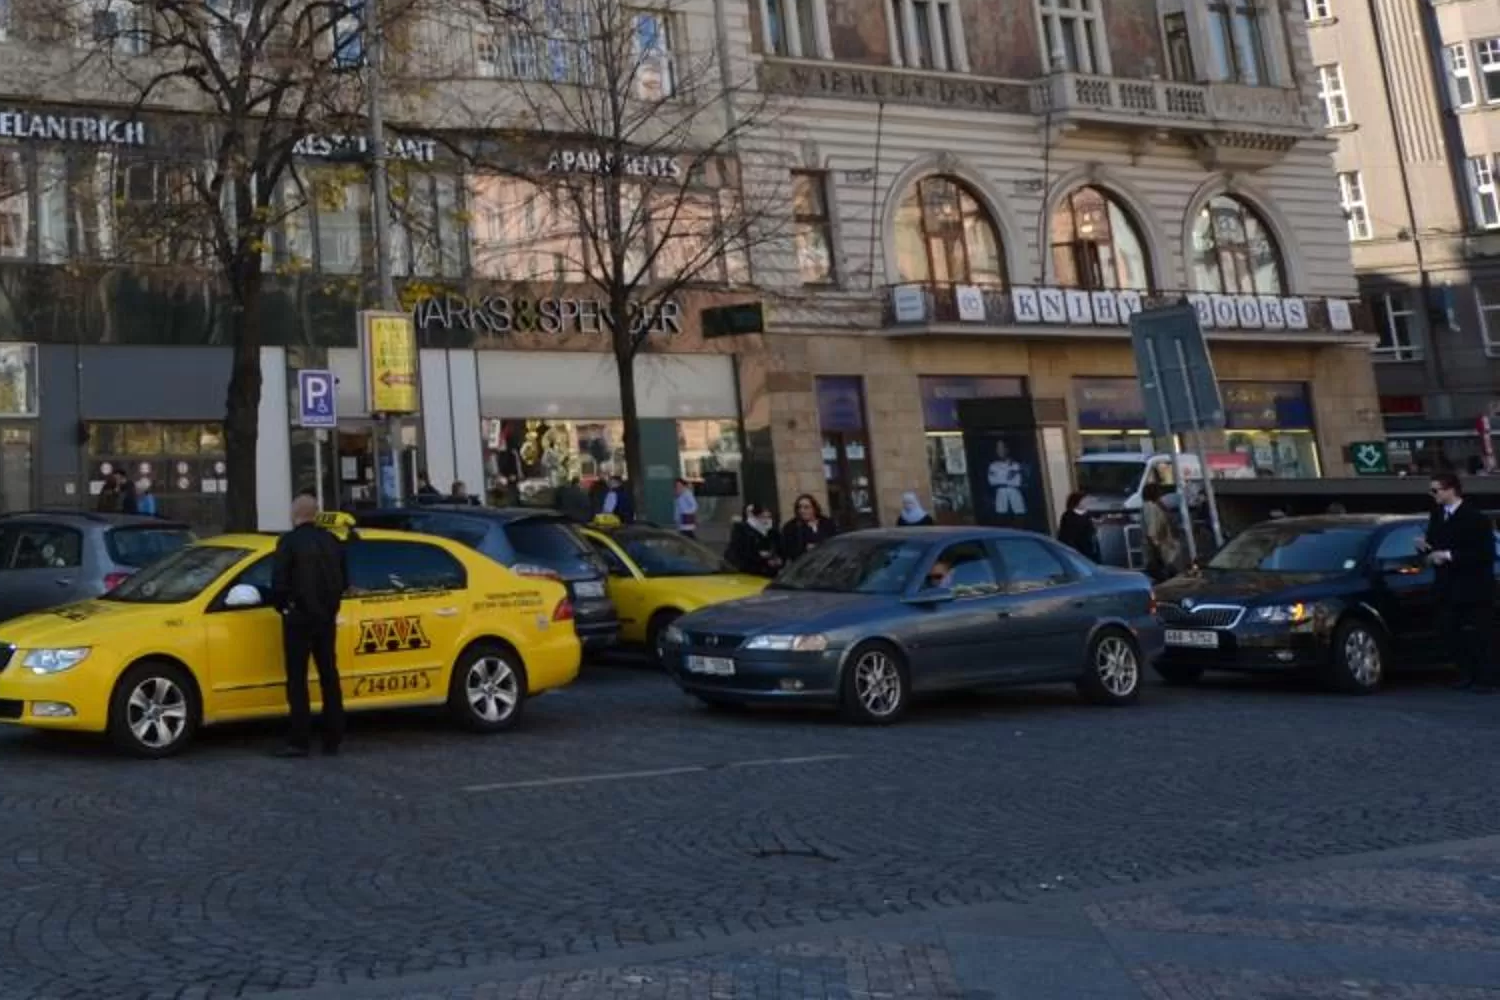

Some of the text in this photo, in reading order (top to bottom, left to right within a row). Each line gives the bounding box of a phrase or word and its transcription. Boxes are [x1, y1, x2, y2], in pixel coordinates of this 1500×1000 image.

[291, 133, 437, 163] RESTANT
[546, 147, 681, 178] APARTENTS
[1017, 293, 1138, 319] KNIHY
[1193, 298, 1305, 323] BOOKS
[306, 376, 328, 409] P
[366, 673, 420, 693] 14014
